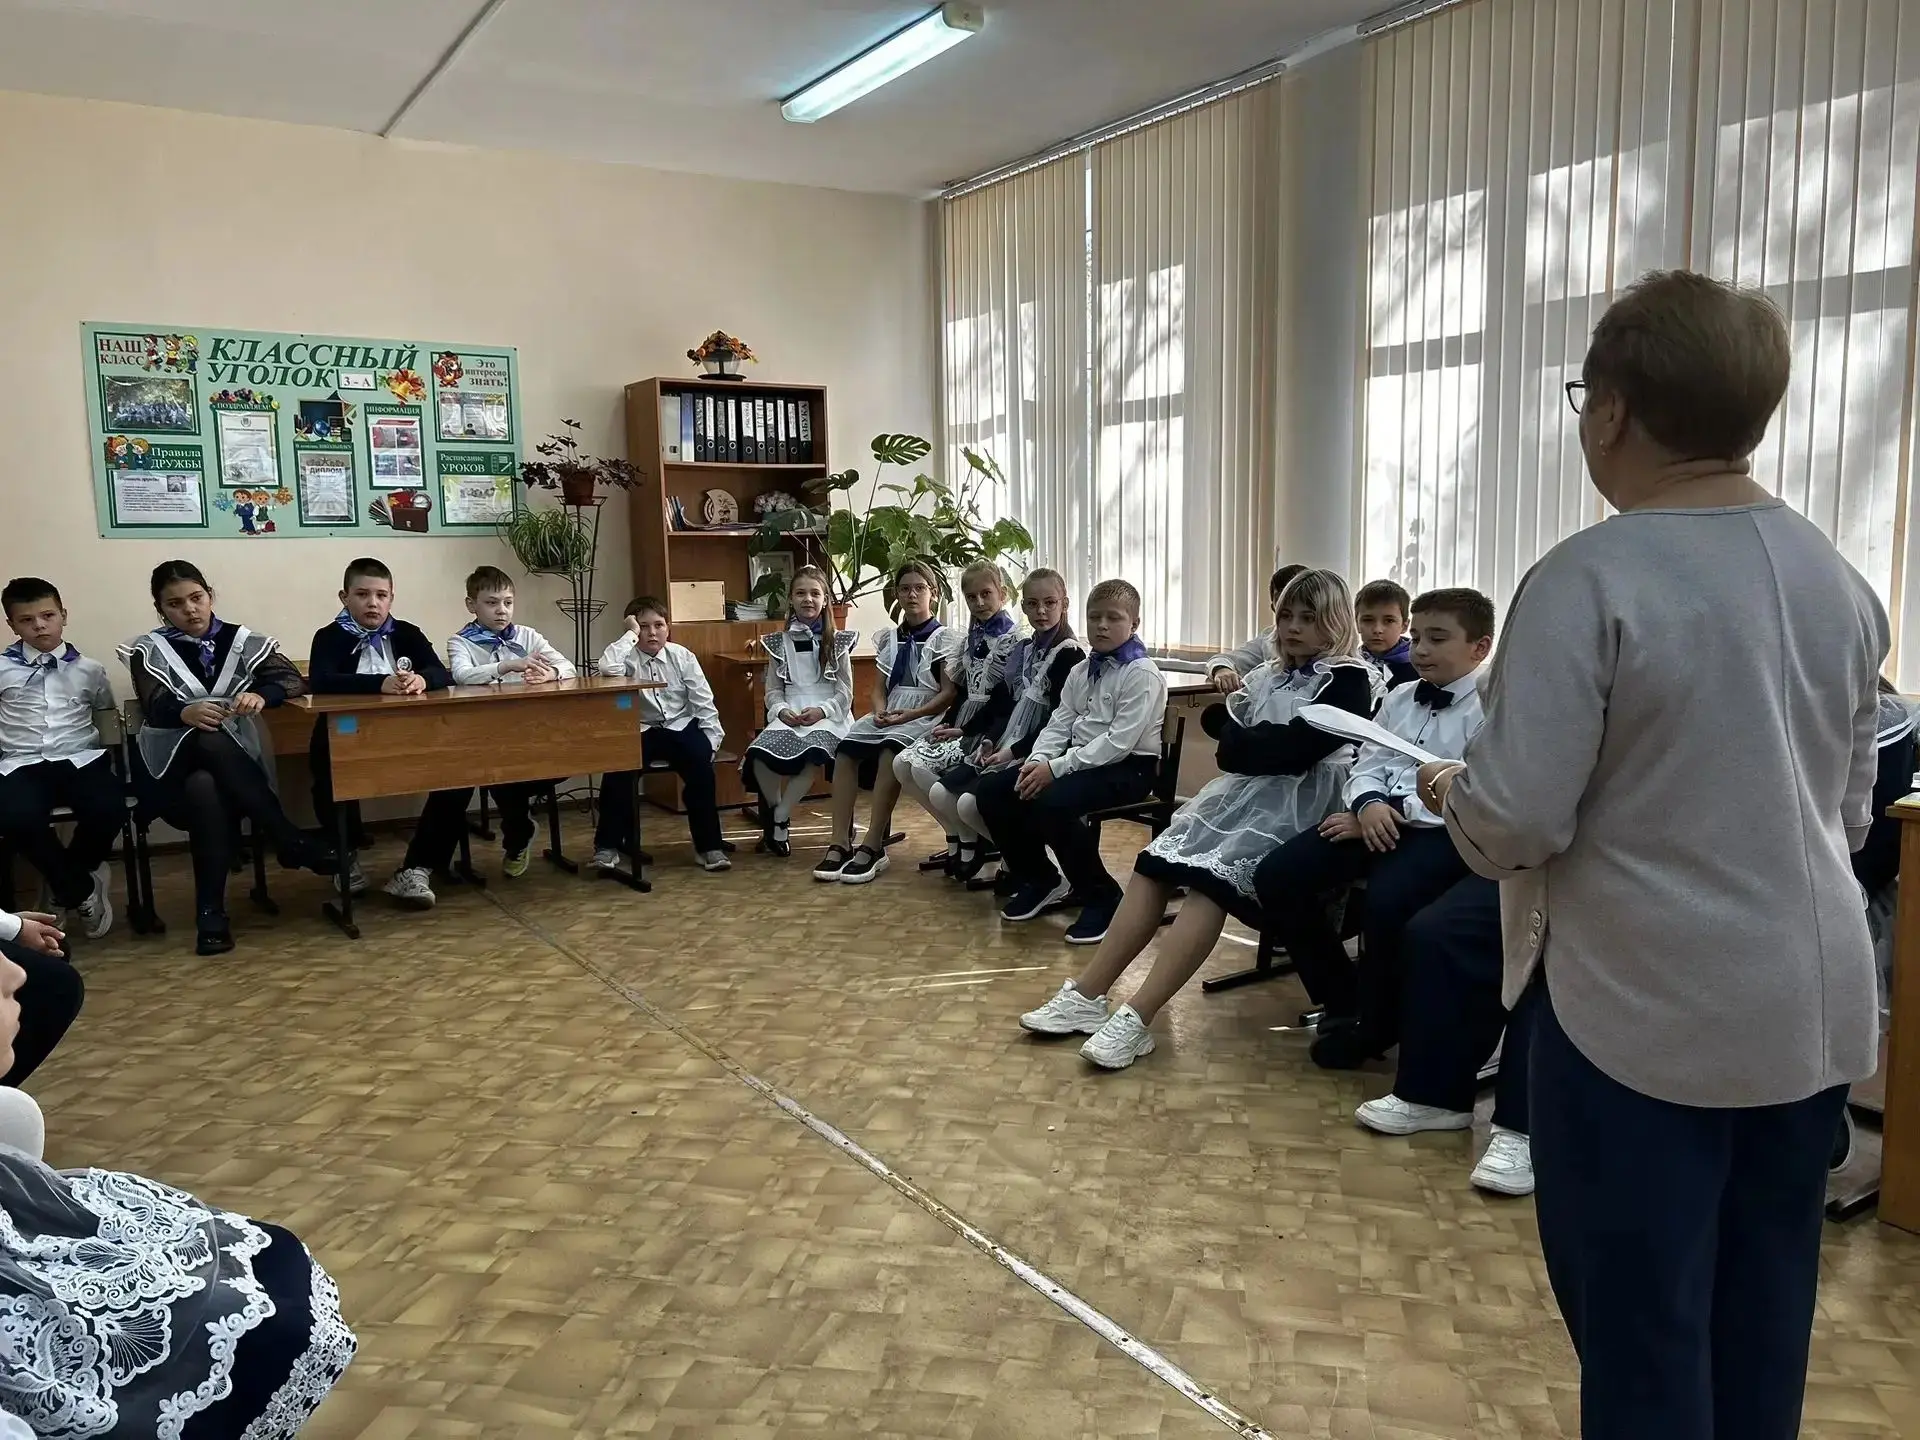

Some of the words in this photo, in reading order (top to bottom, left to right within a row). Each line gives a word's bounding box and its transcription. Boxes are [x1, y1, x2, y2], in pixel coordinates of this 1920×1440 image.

[99, 338, 142, 353] НАШ
[99, 354, 145, 366] КЛАСС
[207, 337, 420, 371] КЛАССНЫЙ
[475, 359, 496, 369] Это
[207, 362, 335, 388] УГОЛОК
[464, 369, 507, 378] интересно
[468, 376, 508, 388] знать!
[366, 405, 421, 415] ИНФОРМАЦИЯ
[151, 447, 201, 459] Правила
[440, 453, 484, 463] Расписание
[150, 458, 202, 470] ДРУЖБЫ
[440, 463, 486, 473] УРОКОВ
